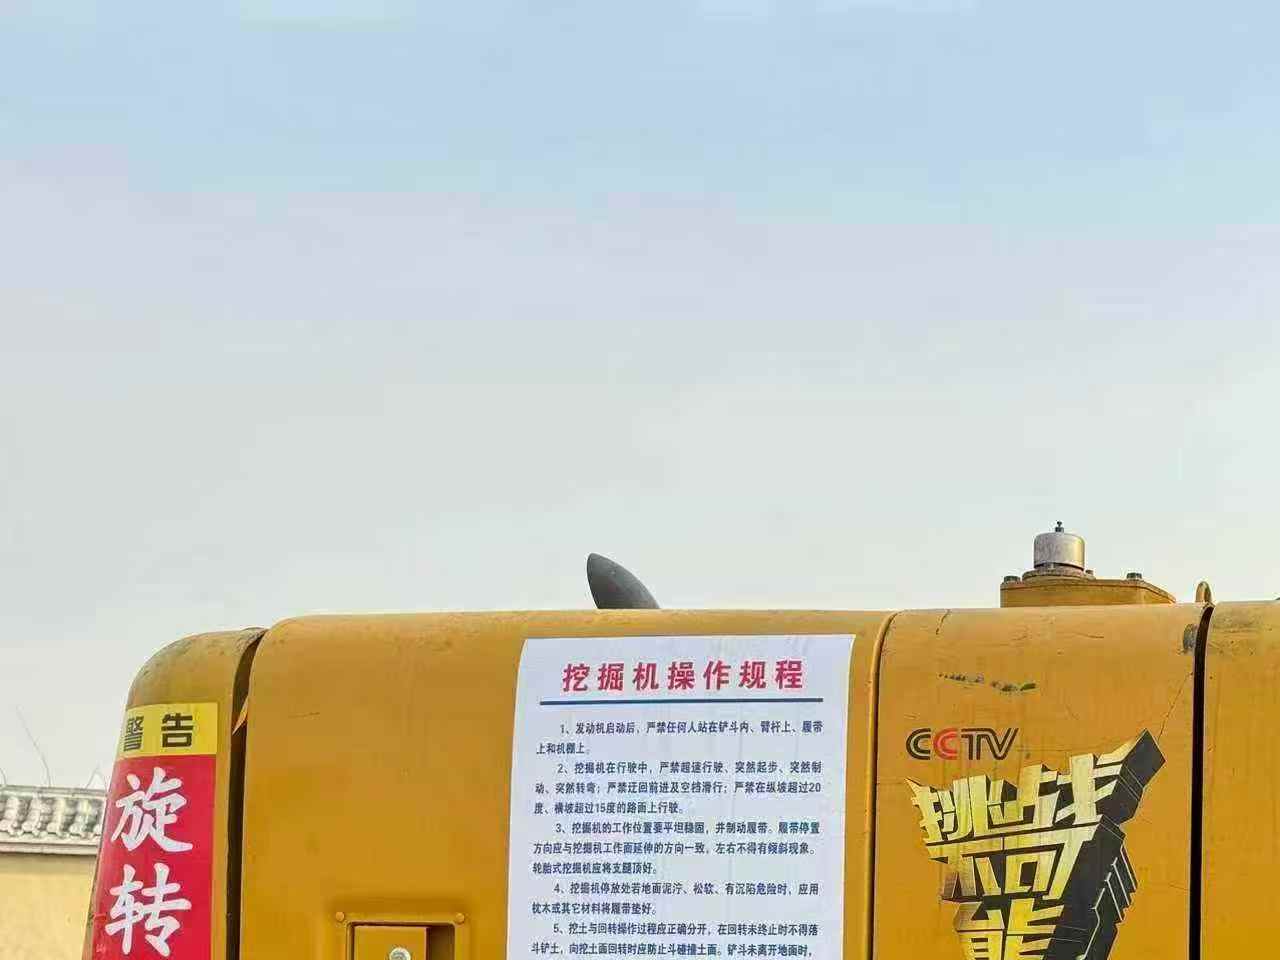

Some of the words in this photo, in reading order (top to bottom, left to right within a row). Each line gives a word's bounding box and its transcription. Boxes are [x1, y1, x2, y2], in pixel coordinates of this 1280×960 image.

[562, 660, 804, 692] 挖掘机操作规程
[123, 712, 194, 751] 警告
[905, 727, 1019, 761] CCTV
[904, 738, 1135, 842] 挑战
[927, 822, 1100, 900] 不可
